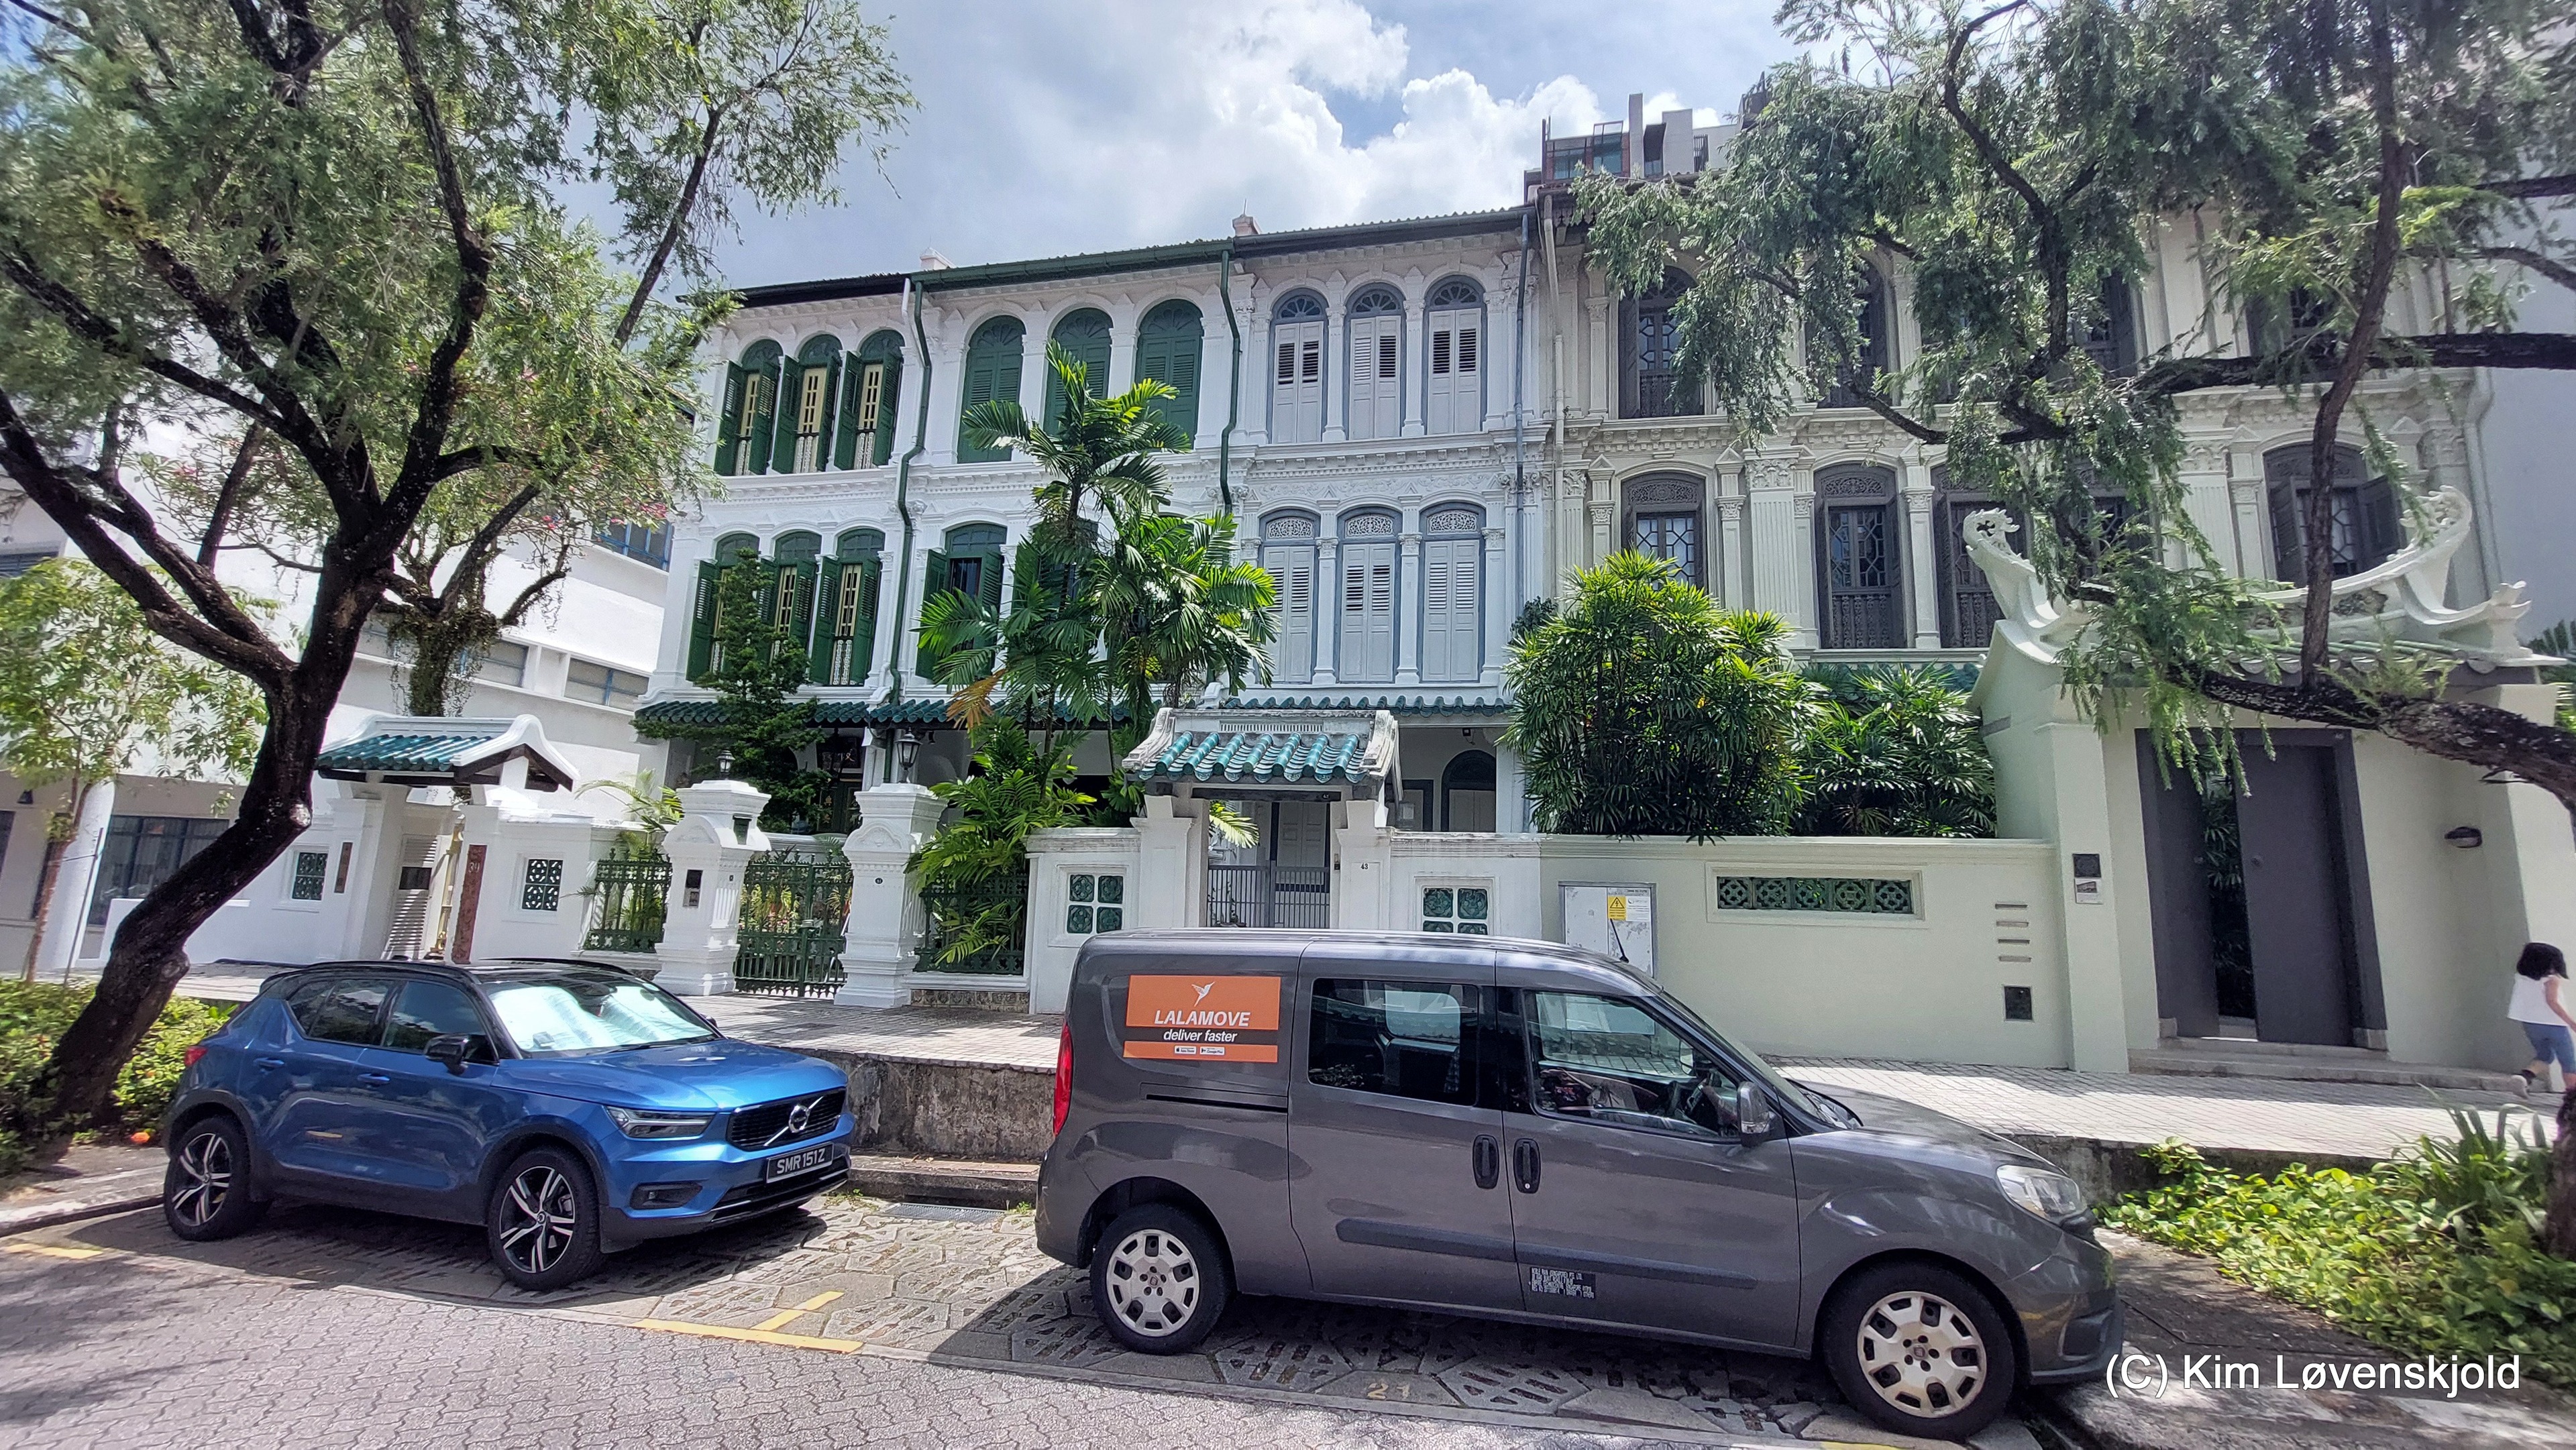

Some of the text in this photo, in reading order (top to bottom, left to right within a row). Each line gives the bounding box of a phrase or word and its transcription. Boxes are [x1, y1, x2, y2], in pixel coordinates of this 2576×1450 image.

[1154, 1009, 1251, 1027] LALAMOVE
[1163, 1029, 1238, 1042] deliver faster
[1367, 1383, 1410, 1399] 21
